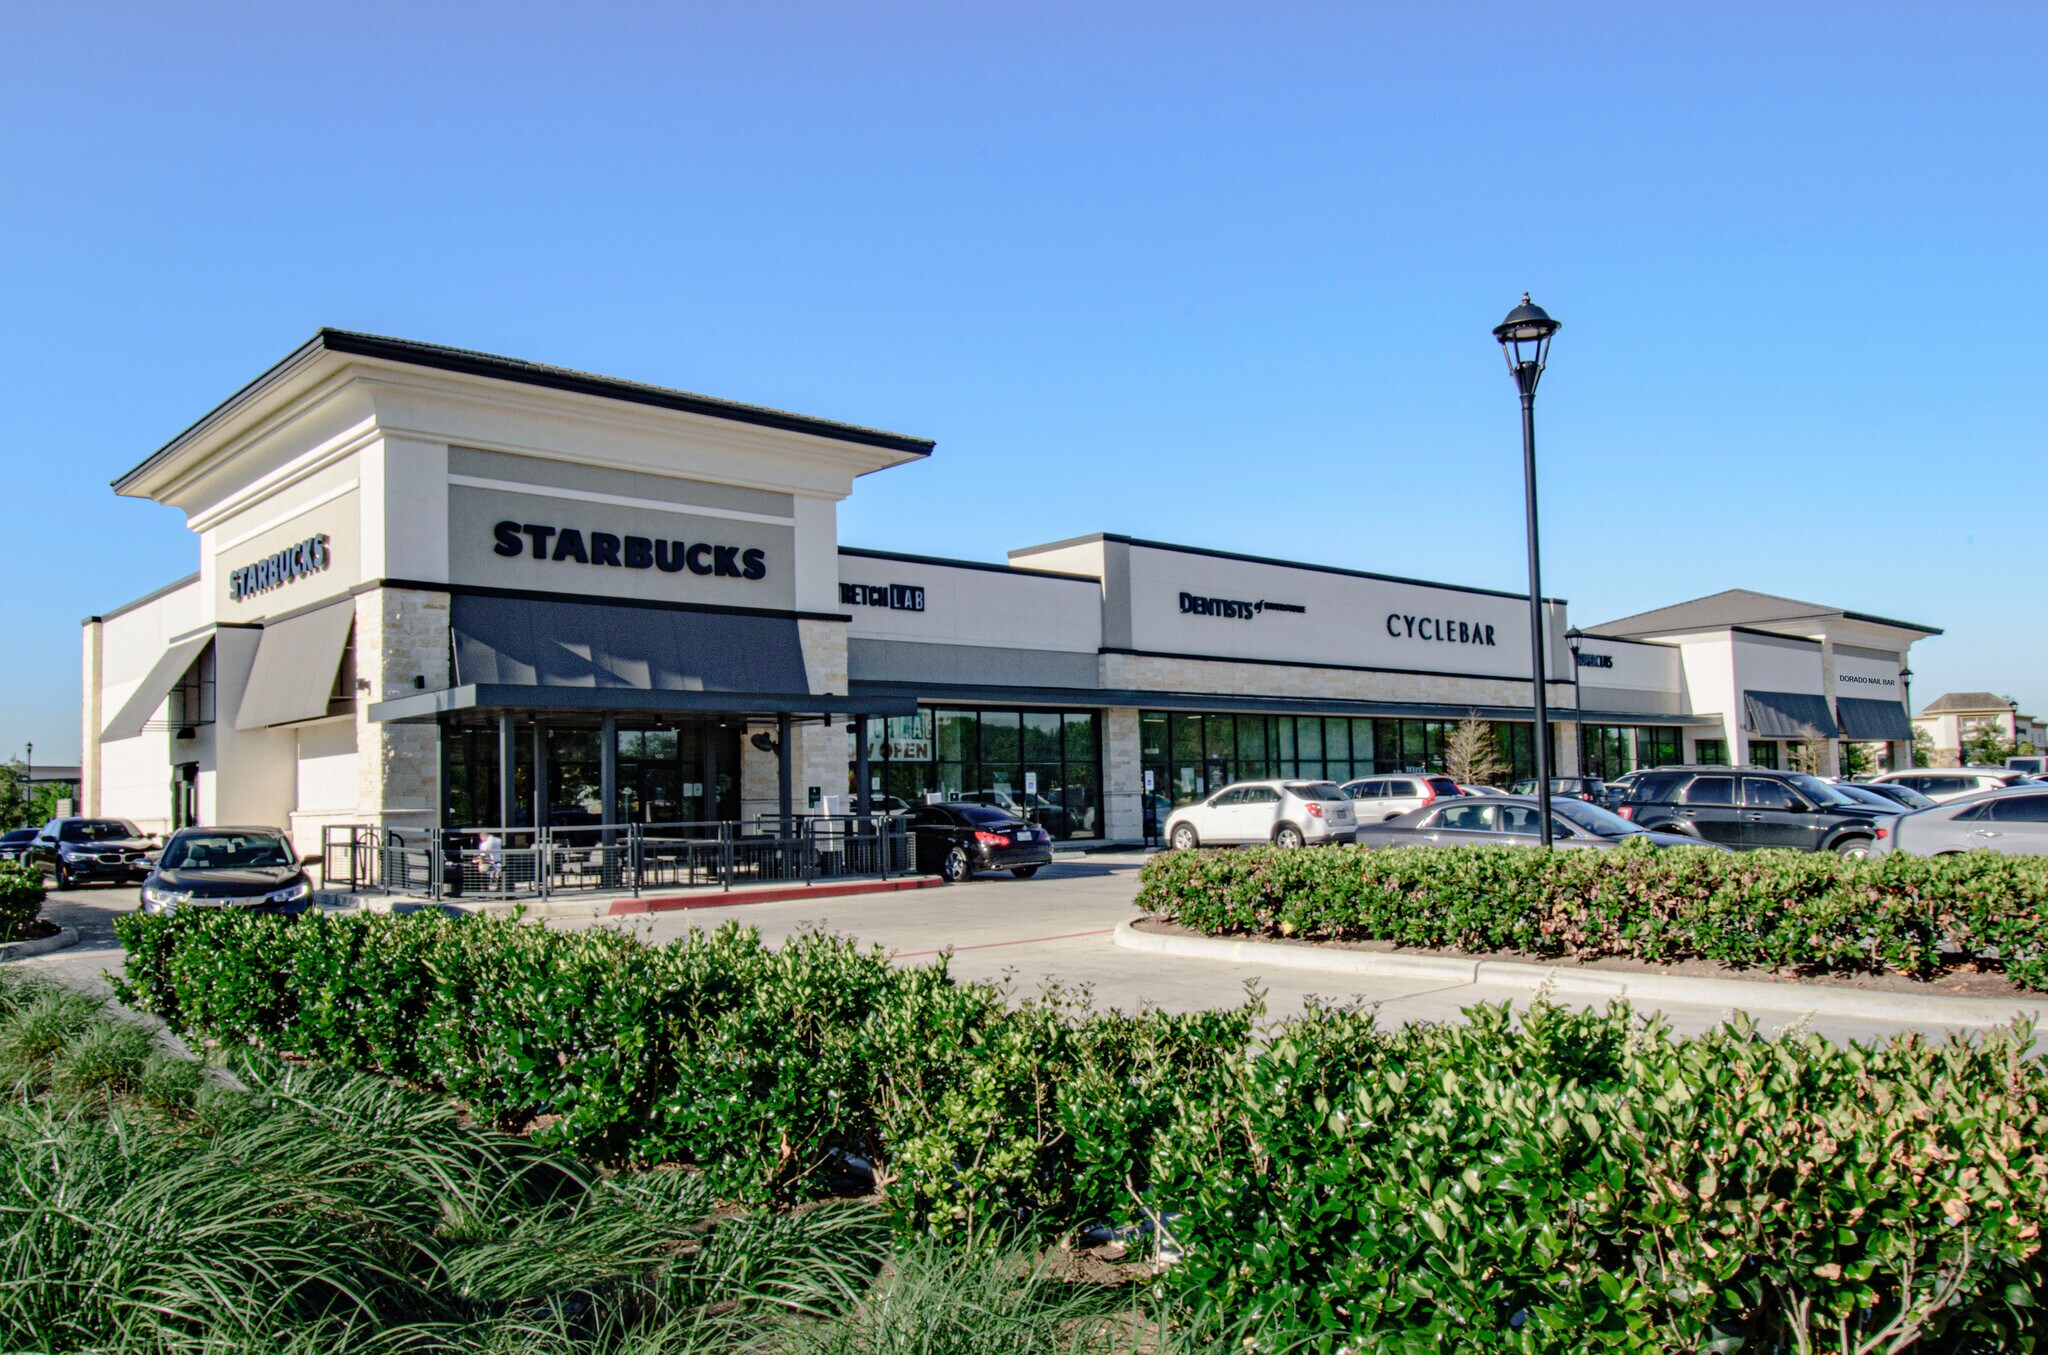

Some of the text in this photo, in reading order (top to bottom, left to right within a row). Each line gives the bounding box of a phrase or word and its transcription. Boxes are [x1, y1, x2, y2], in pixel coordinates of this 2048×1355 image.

[494, 520, 767, 580] STARBUCKS
[229, 533, 327, 601] STARBUCKS
[839, 583, 923, 610] RETCH LAB
[1179, 592, 1253, 620] DENTISTS
[1386, 613, 1496, 646] CYCLEBAR
[1839, 675, 1867, 683] DORADO
[879, 742, 928, 759] OPEN
